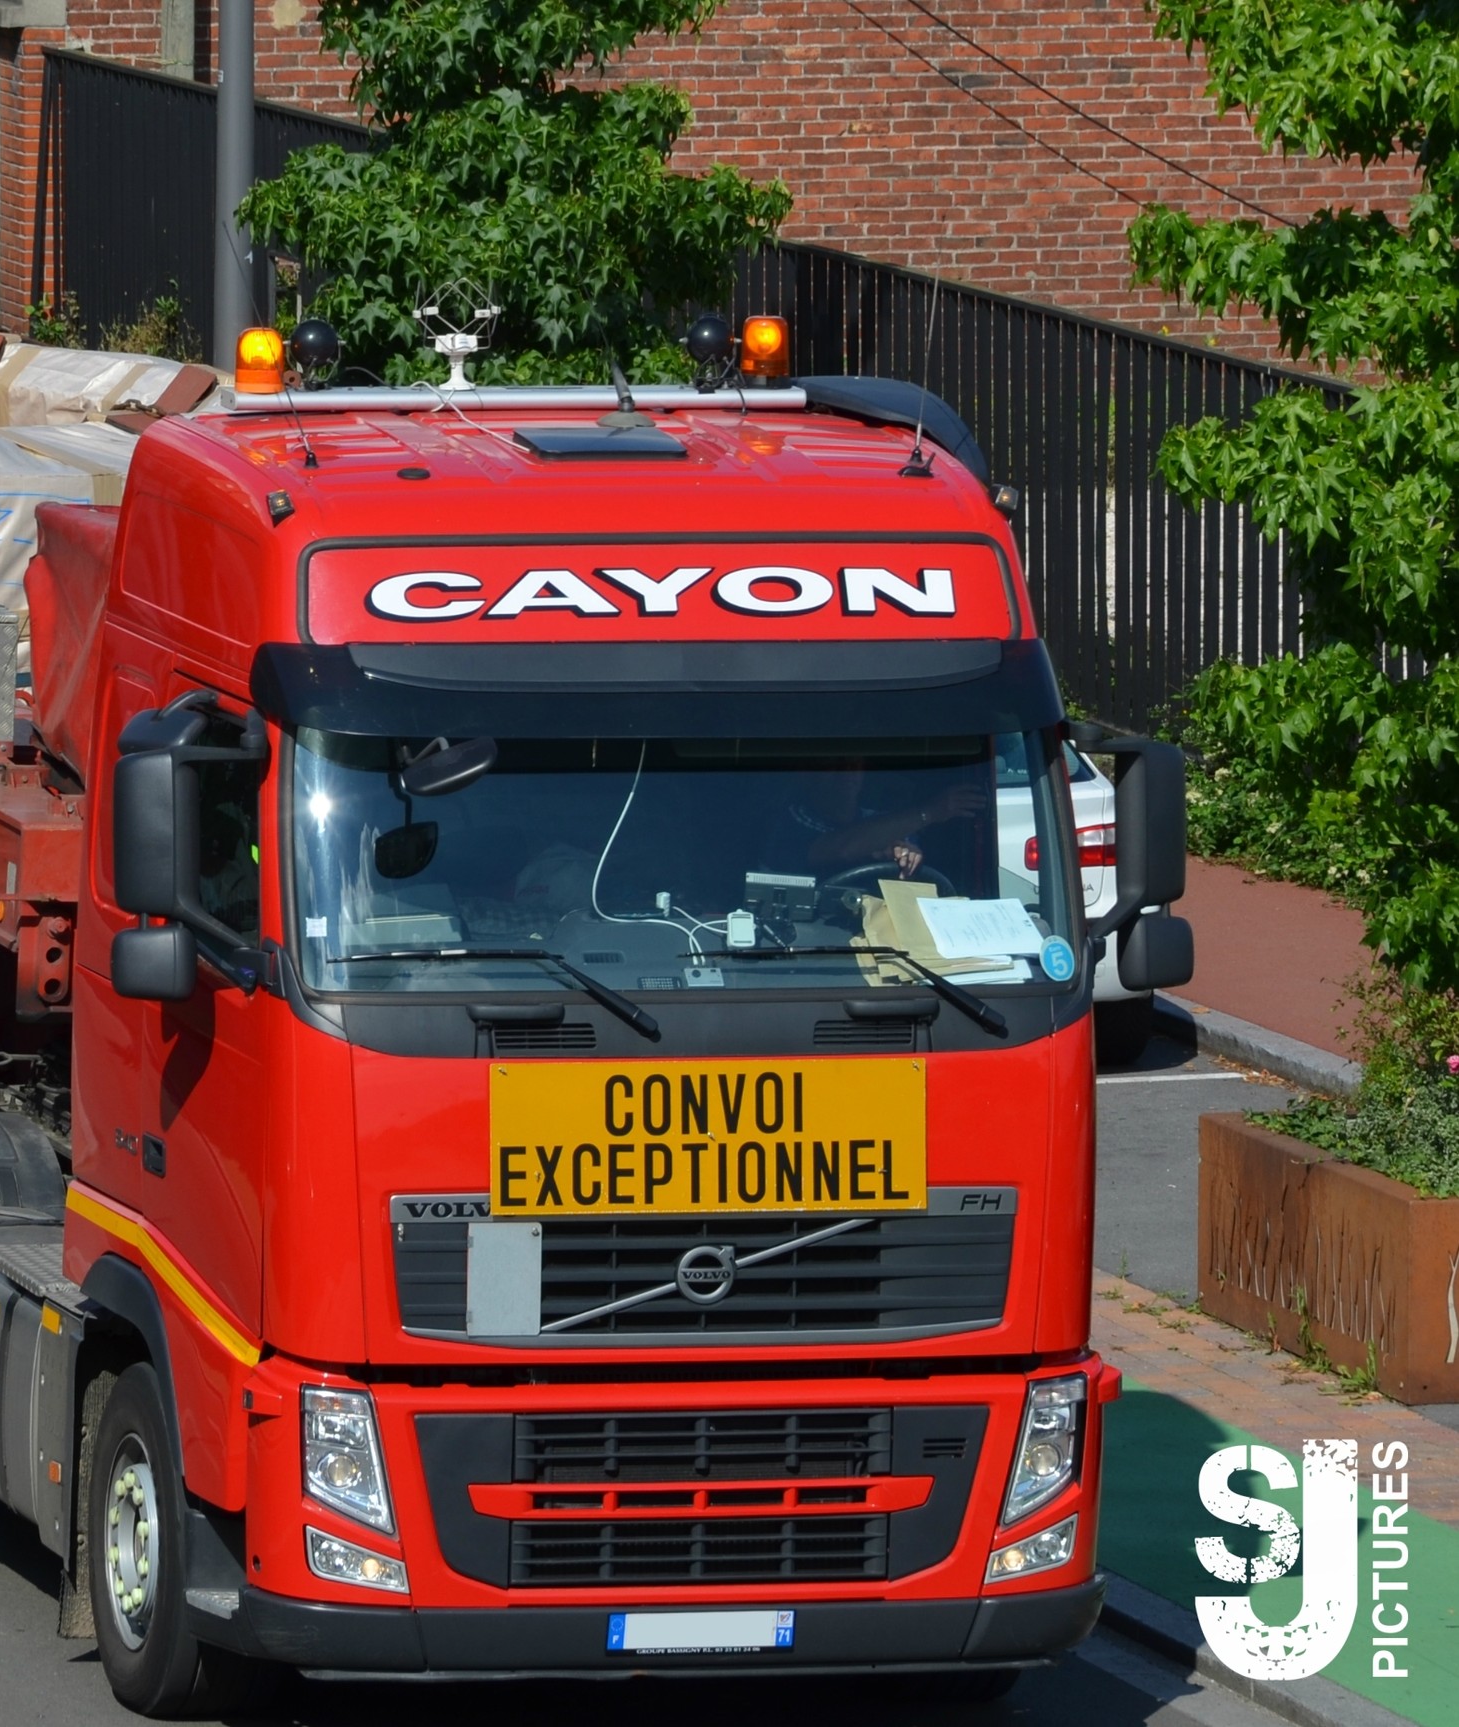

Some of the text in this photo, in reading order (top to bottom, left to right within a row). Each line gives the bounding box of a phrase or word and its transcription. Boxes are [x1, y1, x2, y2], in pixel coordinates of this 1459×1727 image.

[365, 566, 957, 624] CAYON
[1052, 951, 1069, 976] 5
[604, 1071, 804, 1137] CONVOI
[499, 1140, 910, 1207] EXCEPTIONNEL
[402, 1202, 491, 1218] VOLV
[960, 1193, 1002, 1211] FH
[681, 1270, 731, 1280] VOLVO
[778, 1629, 791, 1642] 71
